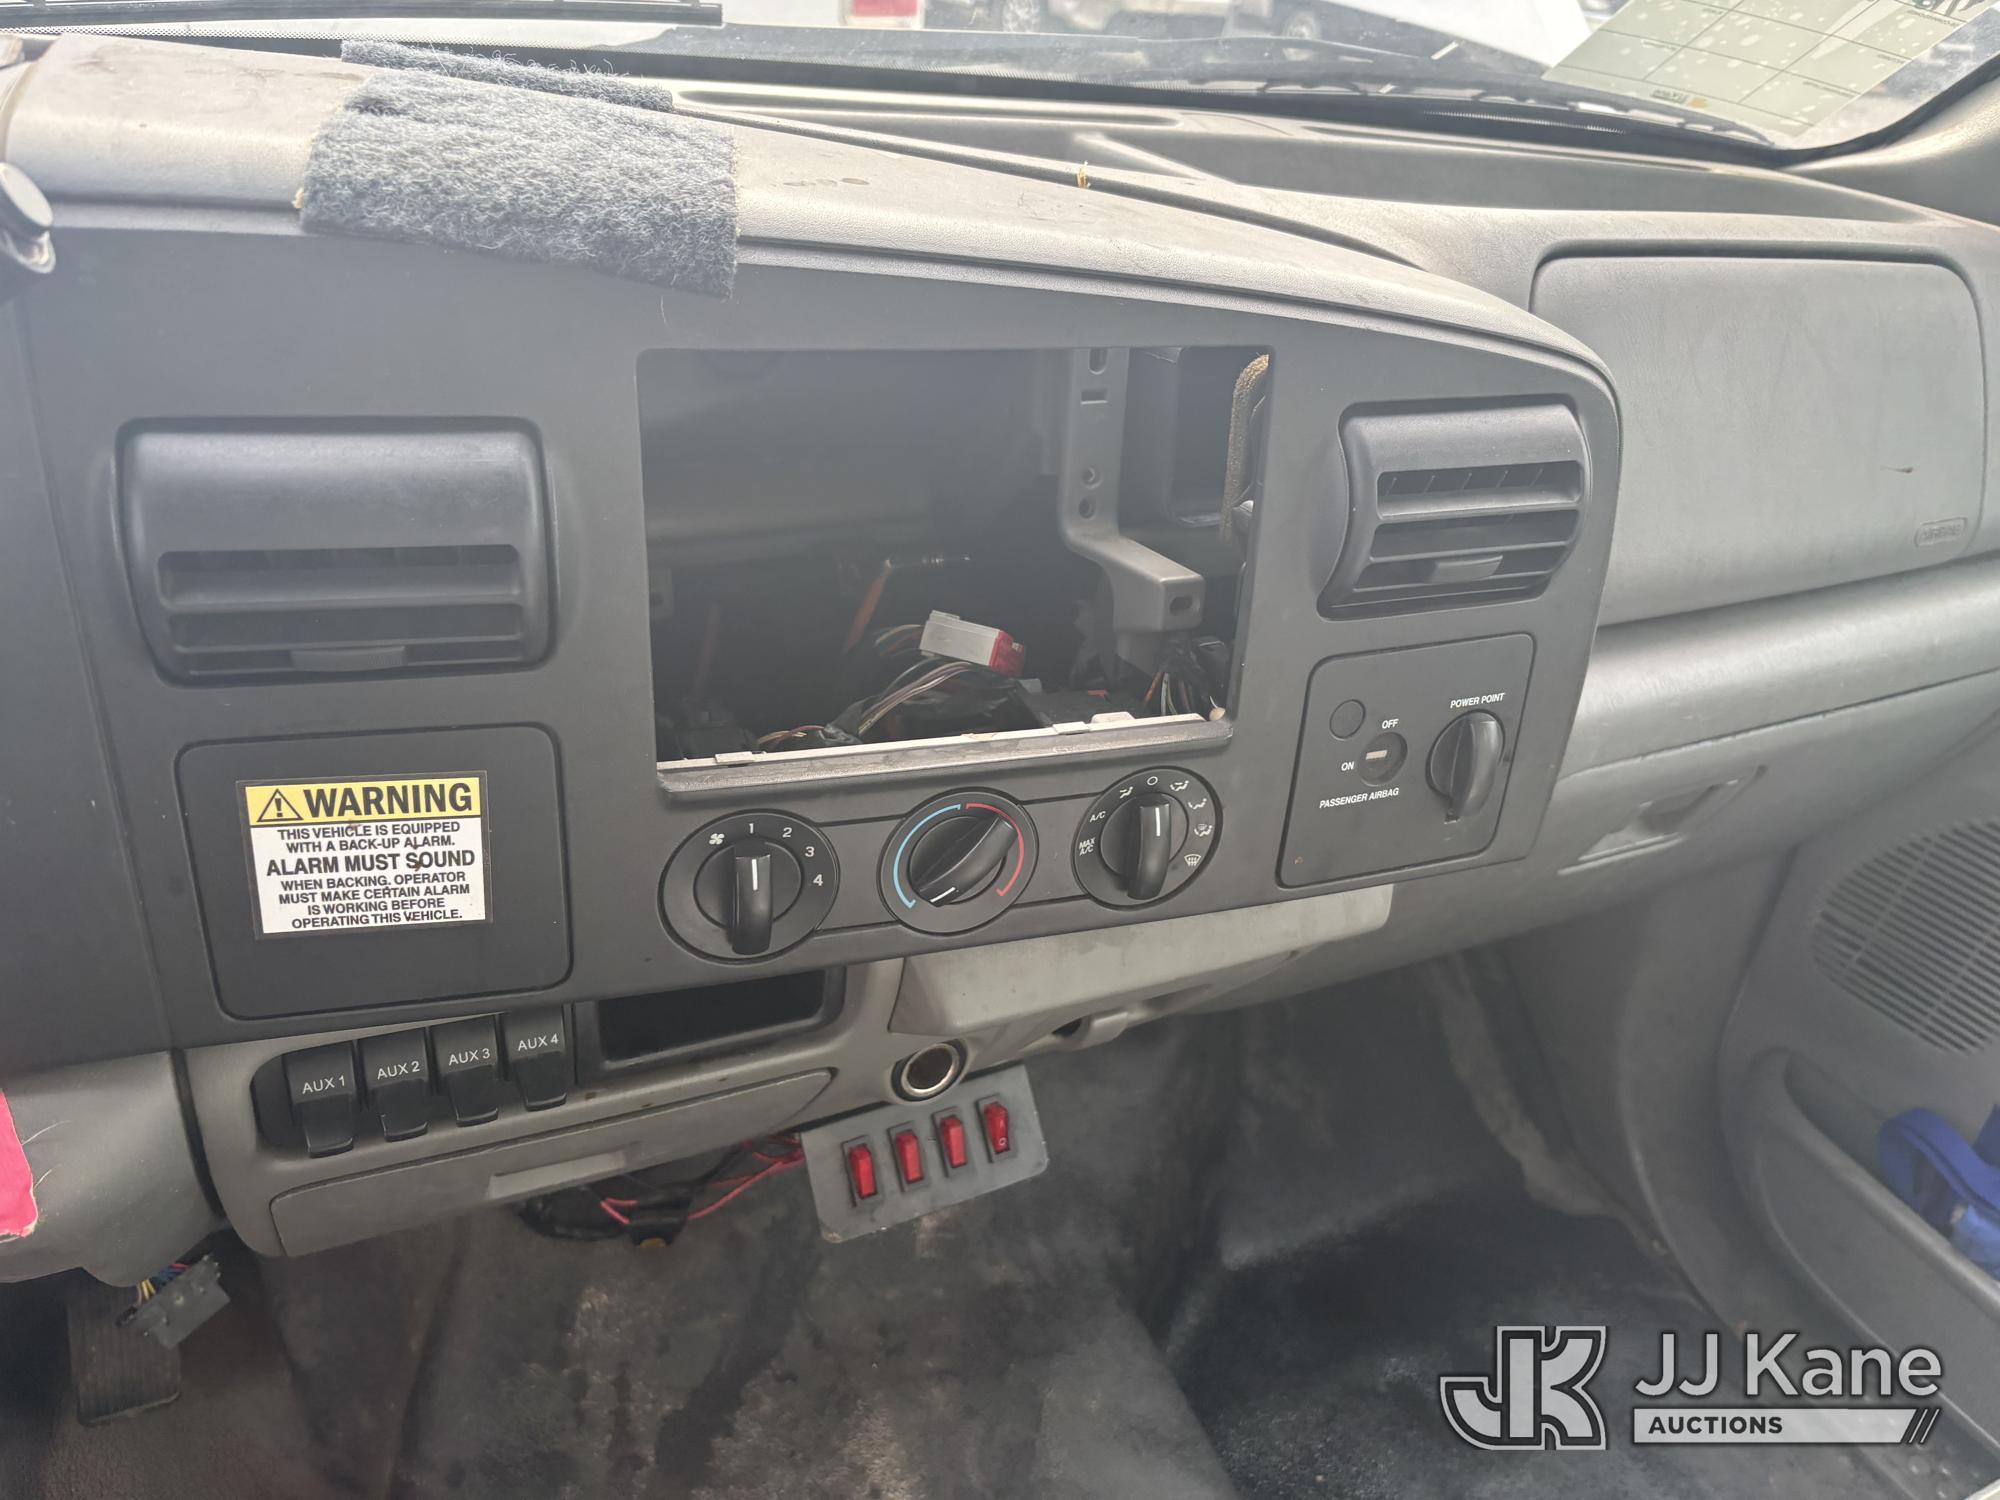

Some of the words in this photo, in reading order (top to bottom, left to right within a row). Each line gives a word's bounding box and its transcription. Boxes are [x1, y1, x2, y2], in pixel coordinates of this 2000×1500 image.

[1450, 695, 1480, 708] POWER
[1480, 692, 1505, 704] POINT
[1382, 718, 1399, 729] OFF
[1341, 762, 1354, 772] ON
[303, 782, 472, 818] WARNING
[1319, 792, 1368, 808] PASSENGER
[1368, 788, 1400, 801] AIRBAG
[1090, 810, 1106, 822] A/C
[277, 827, 310, 840] THIS
[312, 824, 372, 840] VEHICLE
[375, 824, 388, 836] IS
[392, 821, 460, 836] EQUIPPED
[749, 822, 754, 834] 1
[782, 827, 792, 838] 2
[286, 841, 324, 854] WITH
[326, 840, 337, 852] A
[340, 838, 400, 851] BACK-UP
[404, 835, 456, 848] ALARM.
[804, 846, 814, 857] 3
[1079, 837, 1096, 850] MAX
[1080, 844, 1094, 856] A/C
[266, 856, 339, 876] ALARM
[345, 854, 401, 872] MUST
[406, 850, 475, 870] SOUND
[280, 879, 328, 892] WHEN
[330, 876, 392, 889] BACKING.
[394, 872, 466, 885] OPERATOR
[813, 874, 824, 886] 4
[278, 892, 318, 904] MUST
[321, 890, 360, 902] MAKE
[364, 886, 421, 900] CERTAIN
[424, 884, 470, 896] ALARM
[308, 904, 321, 916] IS
[322, 900, 388, 915] WORKING
[392, 898, 446, 911] BEFORE
[292, 914, 370, 929] OPERATING
[371, 912, 402, 924] THIS
[403, 909, 463, 922] VEHICLE.
[518, 1036, 549, 1051] AUX
[550, 1034, 559, 1046] 4
[448, 1050, 479, 1066] AUX
[480, 1048, 490, 1060] 3
[376, 1062, 409, 1080] AUX
[410, 1060, 420, 1073] 2
[302, 1077, 338, 1094] AUX
[339, 1076, 346, 1086] 1
